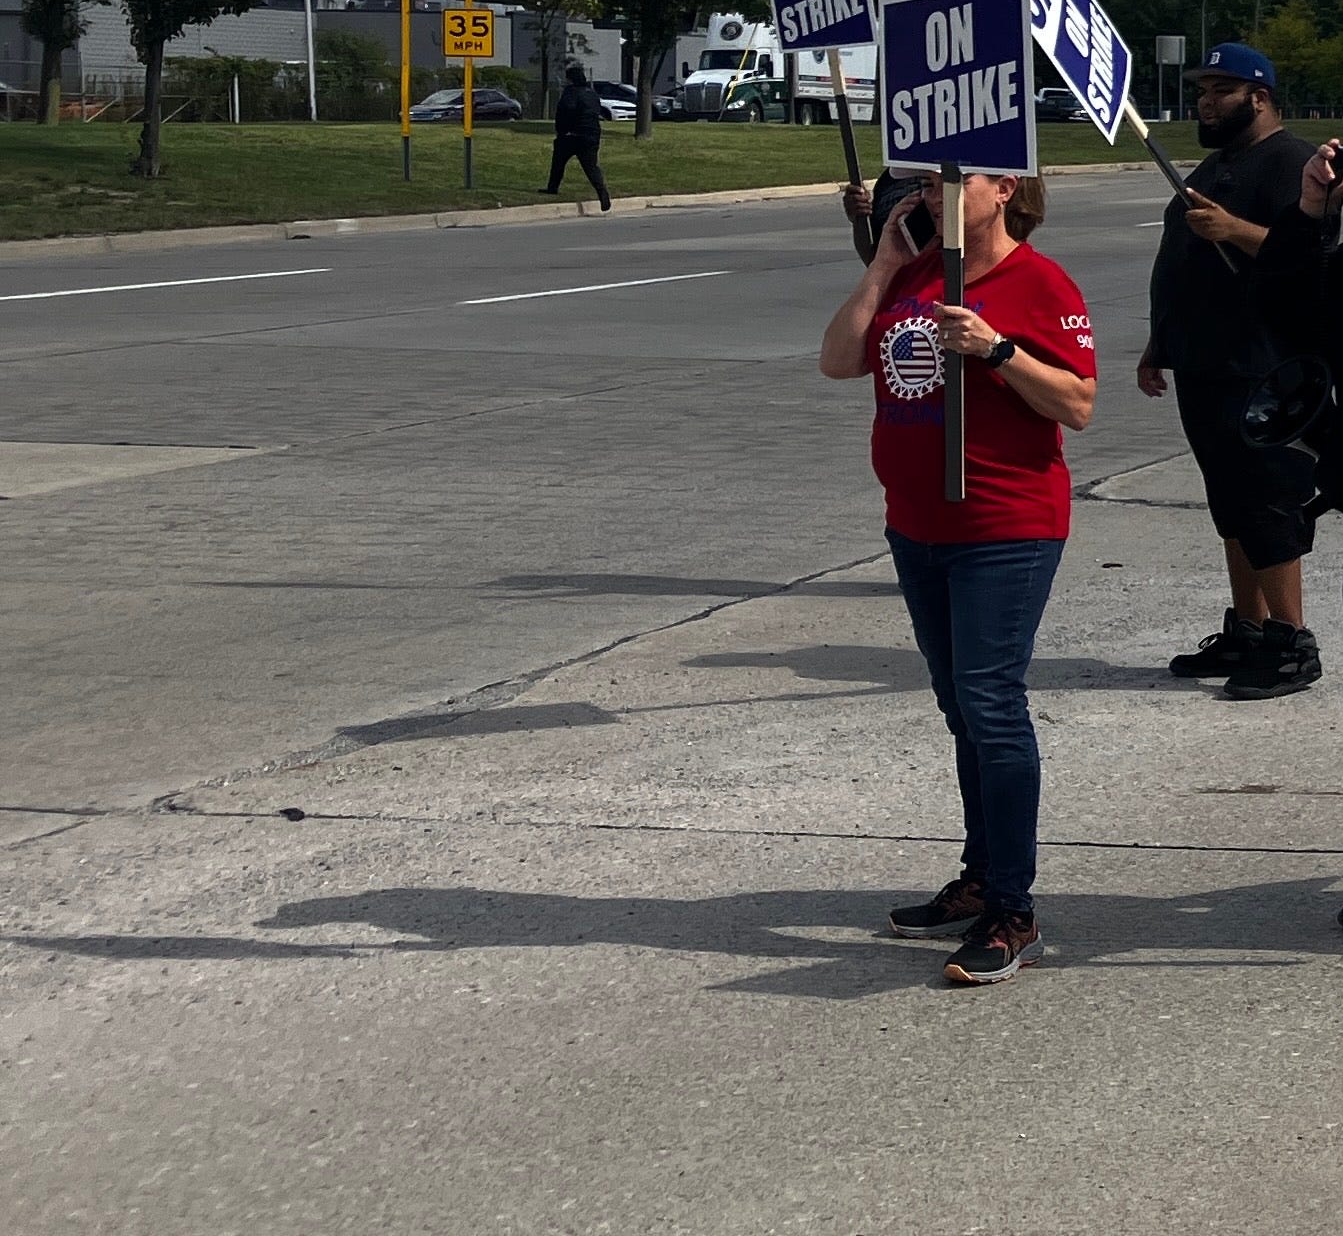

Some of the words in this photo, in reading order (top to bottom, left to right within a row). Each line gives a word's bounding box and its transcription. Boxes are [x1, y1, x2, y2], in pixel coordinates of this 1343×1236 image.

[448, 15, 489, 38] 35
[453, 41, 483, 52] MPH
[925, 2, 975, 73] ON
[1086, 1, 1114, 126] STRIKE
[892, 60, 1019, 151] STRIKE
